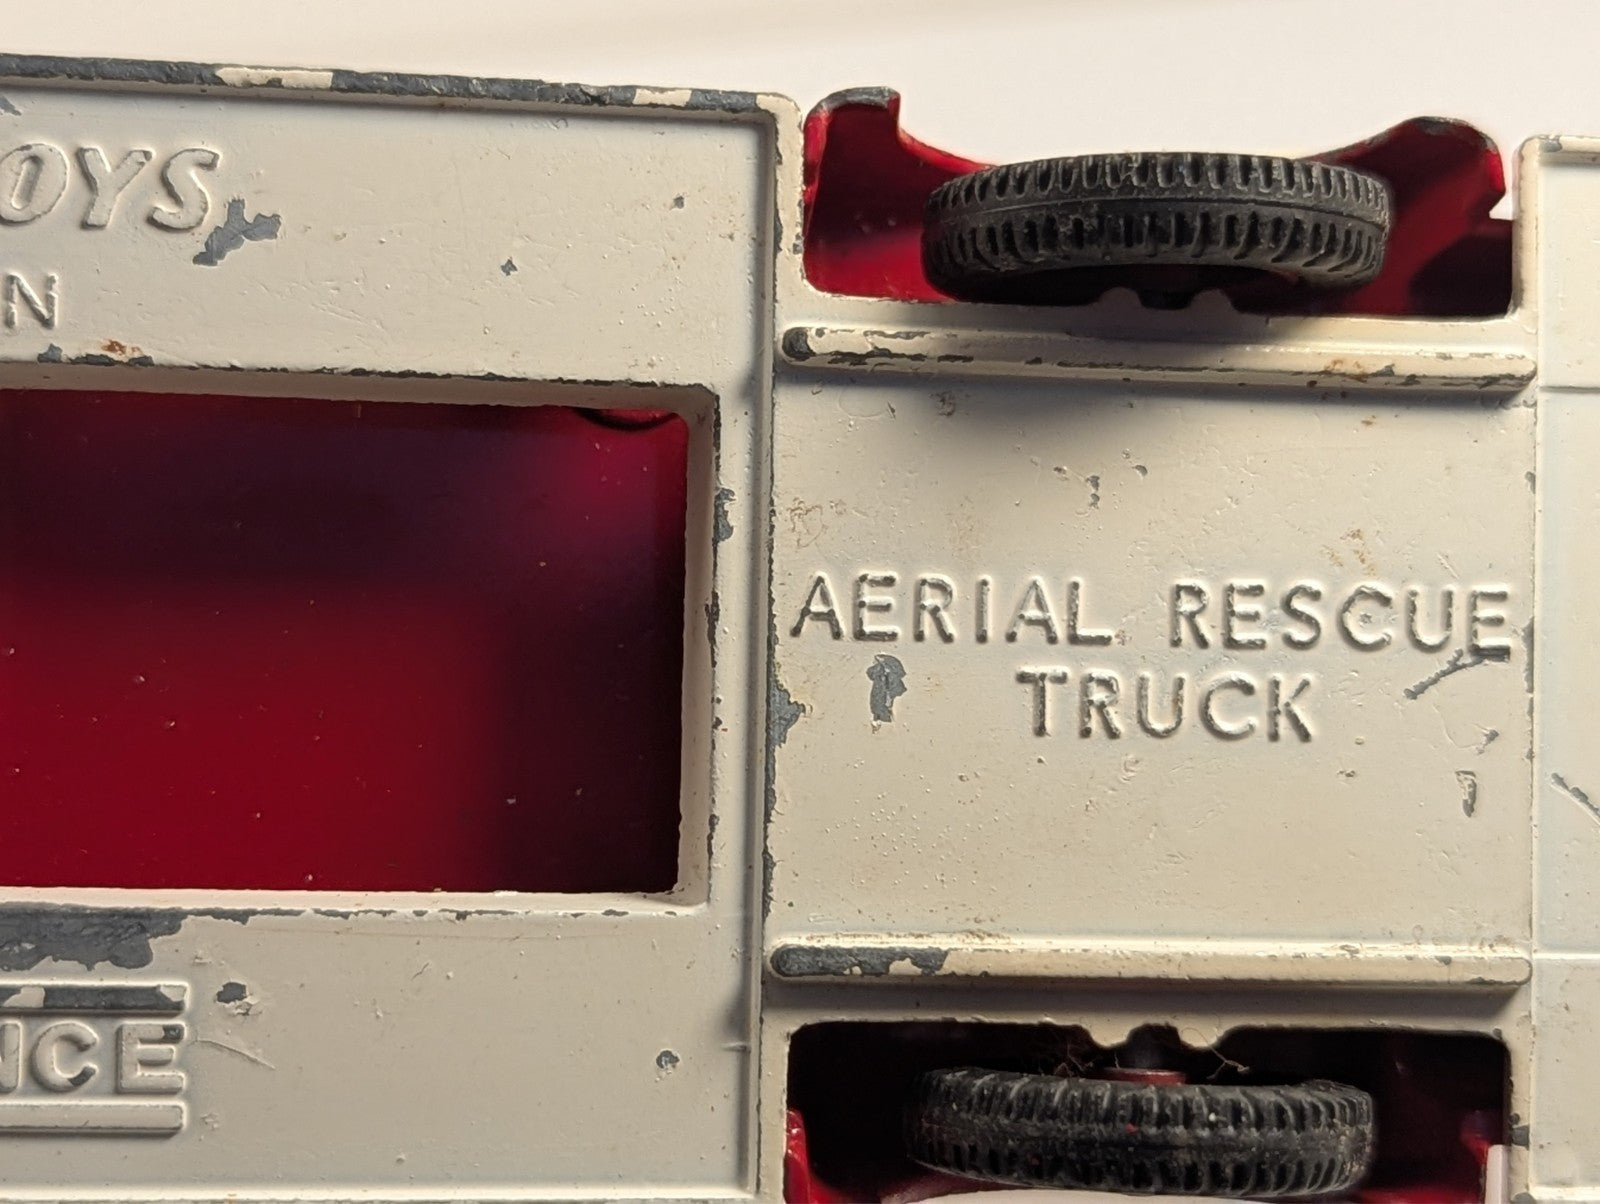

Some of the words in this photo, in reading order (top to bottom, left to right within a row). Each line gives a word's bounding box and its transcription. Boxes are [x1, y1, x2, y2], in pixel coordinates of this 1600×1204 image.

[4, 271, 59, 330] N
[789, 571, 1115, 645] AERIAL
[1169, 577, 1514, 662] RESCUE
[1015, 666, 1317, 743] TRUCK
